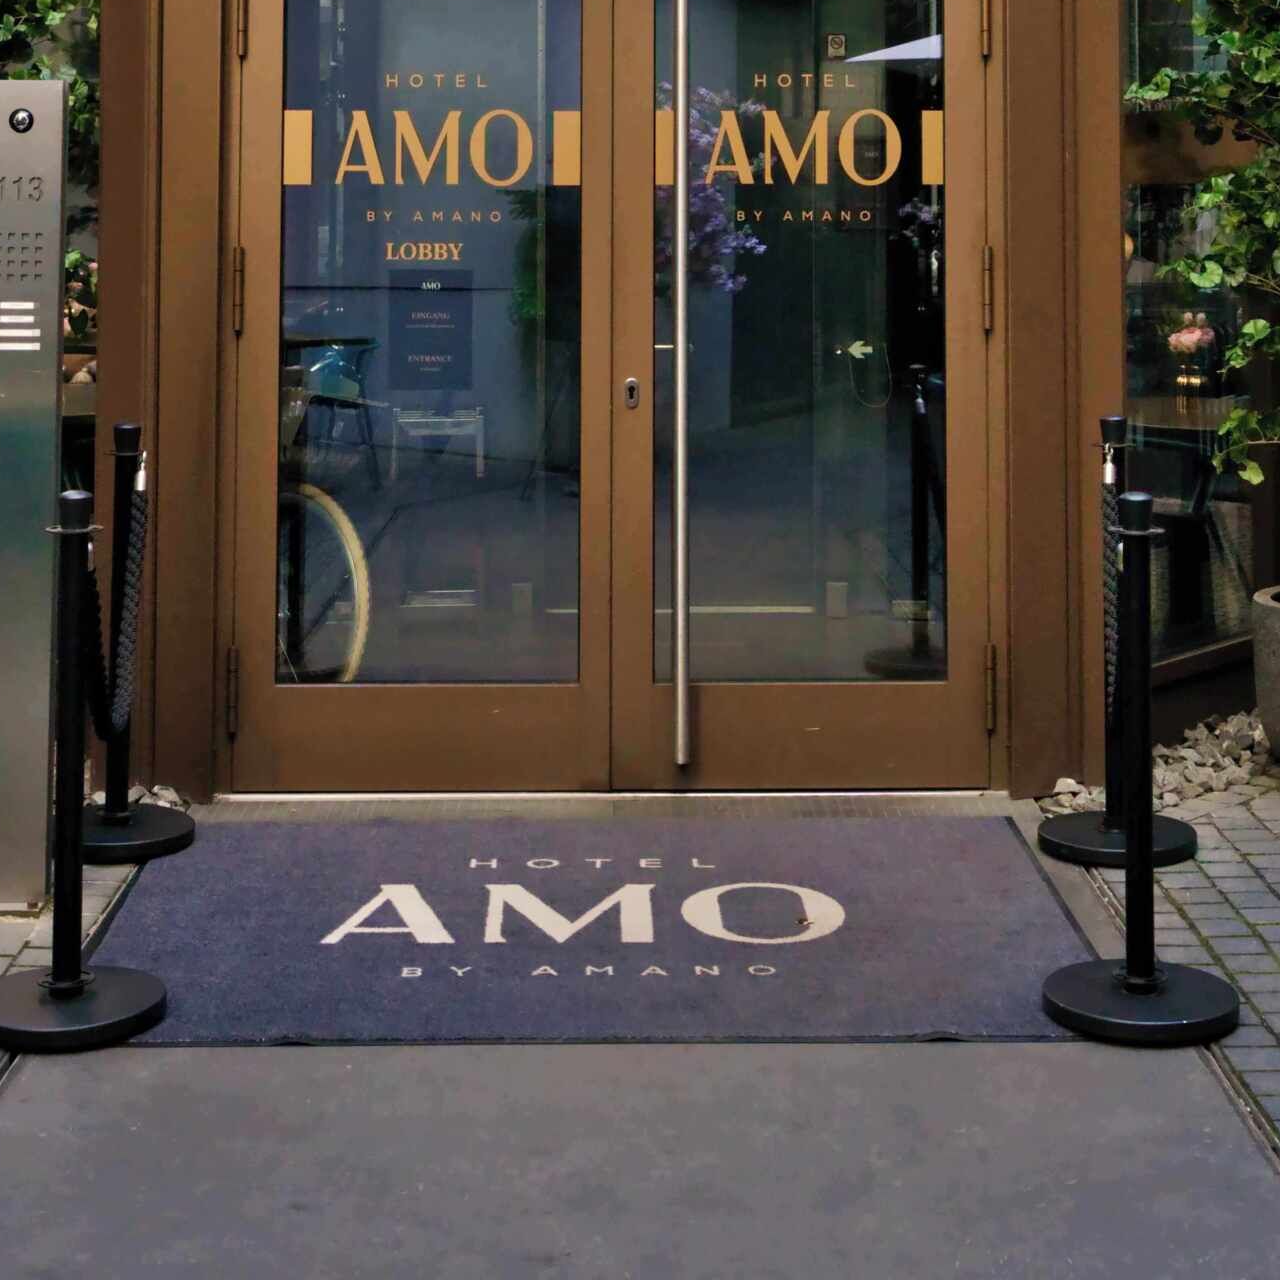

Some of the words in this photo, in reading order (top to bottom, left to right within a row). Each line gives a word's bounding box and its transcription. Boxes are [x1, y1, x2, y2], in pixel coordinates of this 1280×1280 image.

[385, 73, 488, 89] HOTEL
[753, 73, 856, 89] HOTEL
[334, 107, 534, 188] AMO
[704, 107, 903, 188] AMO
[366, 209, 394, 223] BY
[413, 209, 503, 223] AMANO
[735, 209, 763, 223] BY
[782, 209, 873, 223] AMANO
[385, 241, 463, 261] LOBBY
[421, 280, 441, 291] AMO
[469, 857, 716, 869] HOTEL
[320, 882, 847, 945] AMO
[401, 966, 472, 979] BY
[531, 964, 778, 976] AMANO
